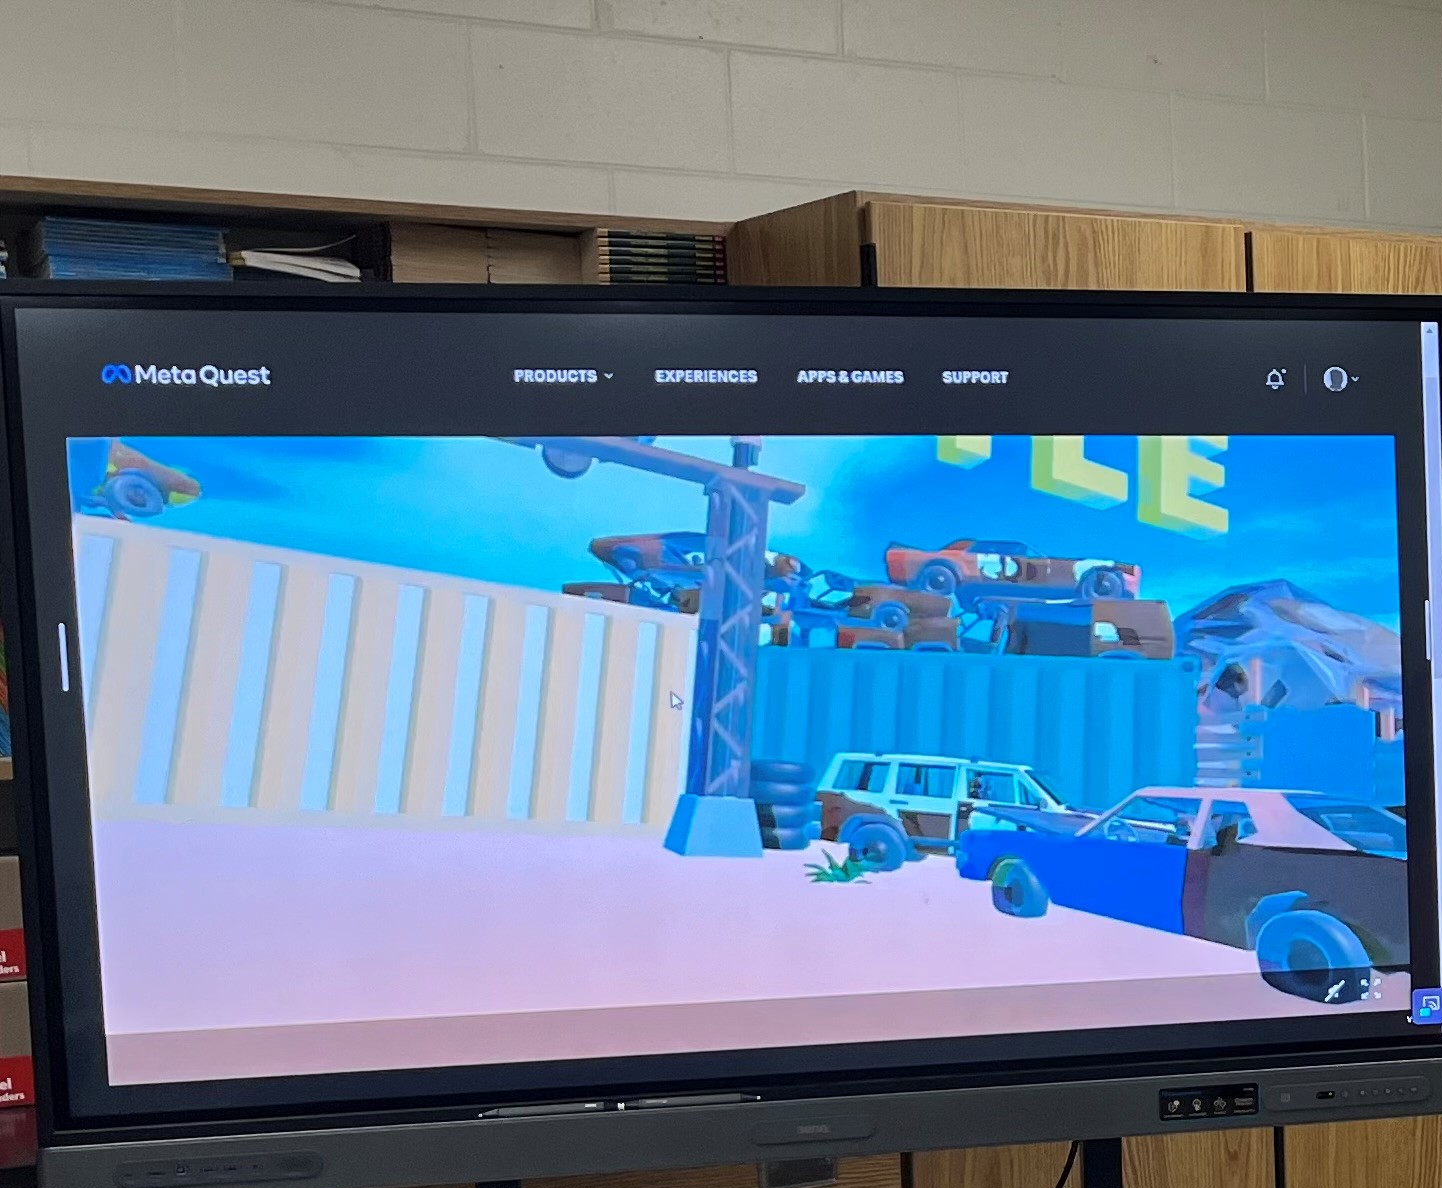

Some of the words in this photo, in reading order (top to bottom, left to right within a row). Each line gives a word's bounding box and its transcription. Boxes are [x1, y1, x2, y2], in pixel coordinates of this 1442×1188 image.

[134, 364, 196, 385] Meta
[199, 364, 271, 387] Quest
[513, 368, 598, 384] PRODUCTS
[654, 368, 758, 384] EXPERIENCES
[797, 369, 837, 384] APPS
[838, 369, 850, 384] &
[851, 369, 904, 384] GAMES
[942, 369, 1009, 385] SUPPORT
